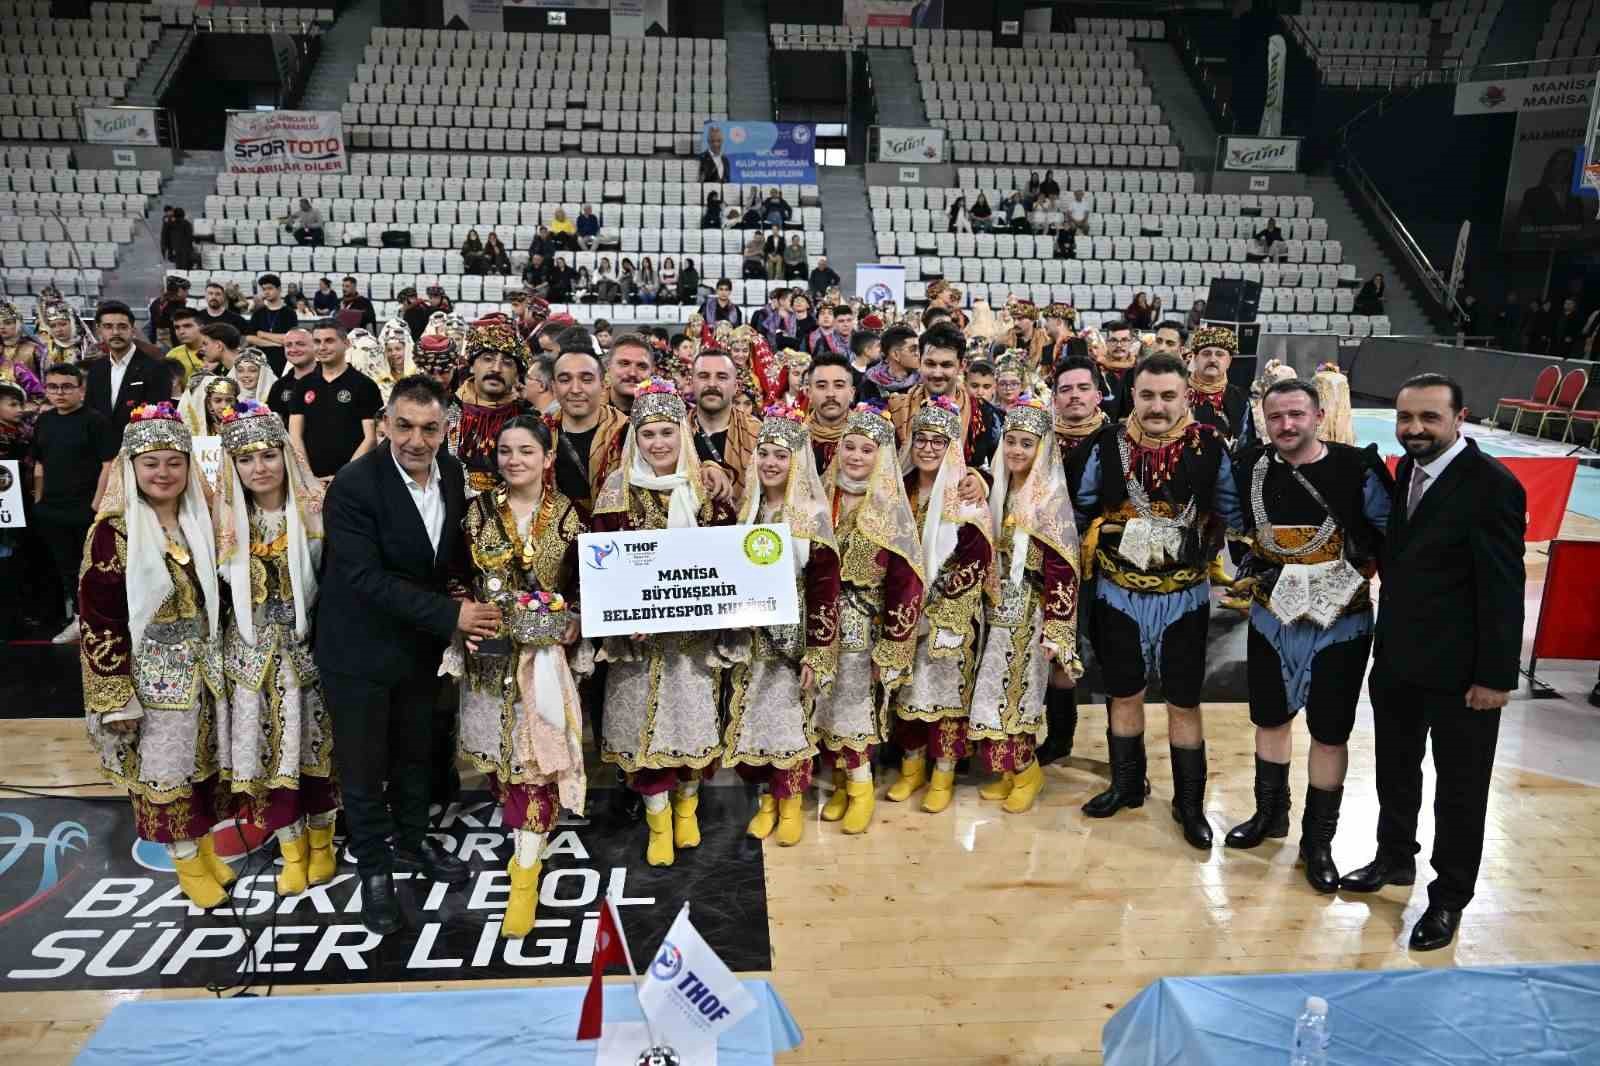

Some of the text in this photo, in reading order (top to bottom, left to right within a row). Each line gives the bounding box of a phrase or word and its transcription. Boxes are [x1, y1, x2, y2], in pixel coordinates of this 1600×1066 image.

[1522, 94, 1587, 106] MANİSA
[623, 541, 658, 553] THOF
[657, 565, 719, 582] MANİSA
[641, 582, 737, 601] BÜYÜKŞEHİR
[603, 603, 714, 622] BELEDİYESPOR
[7, 921, 384, 979] SÜPER
[677, 970, 731, 1022] THOF
